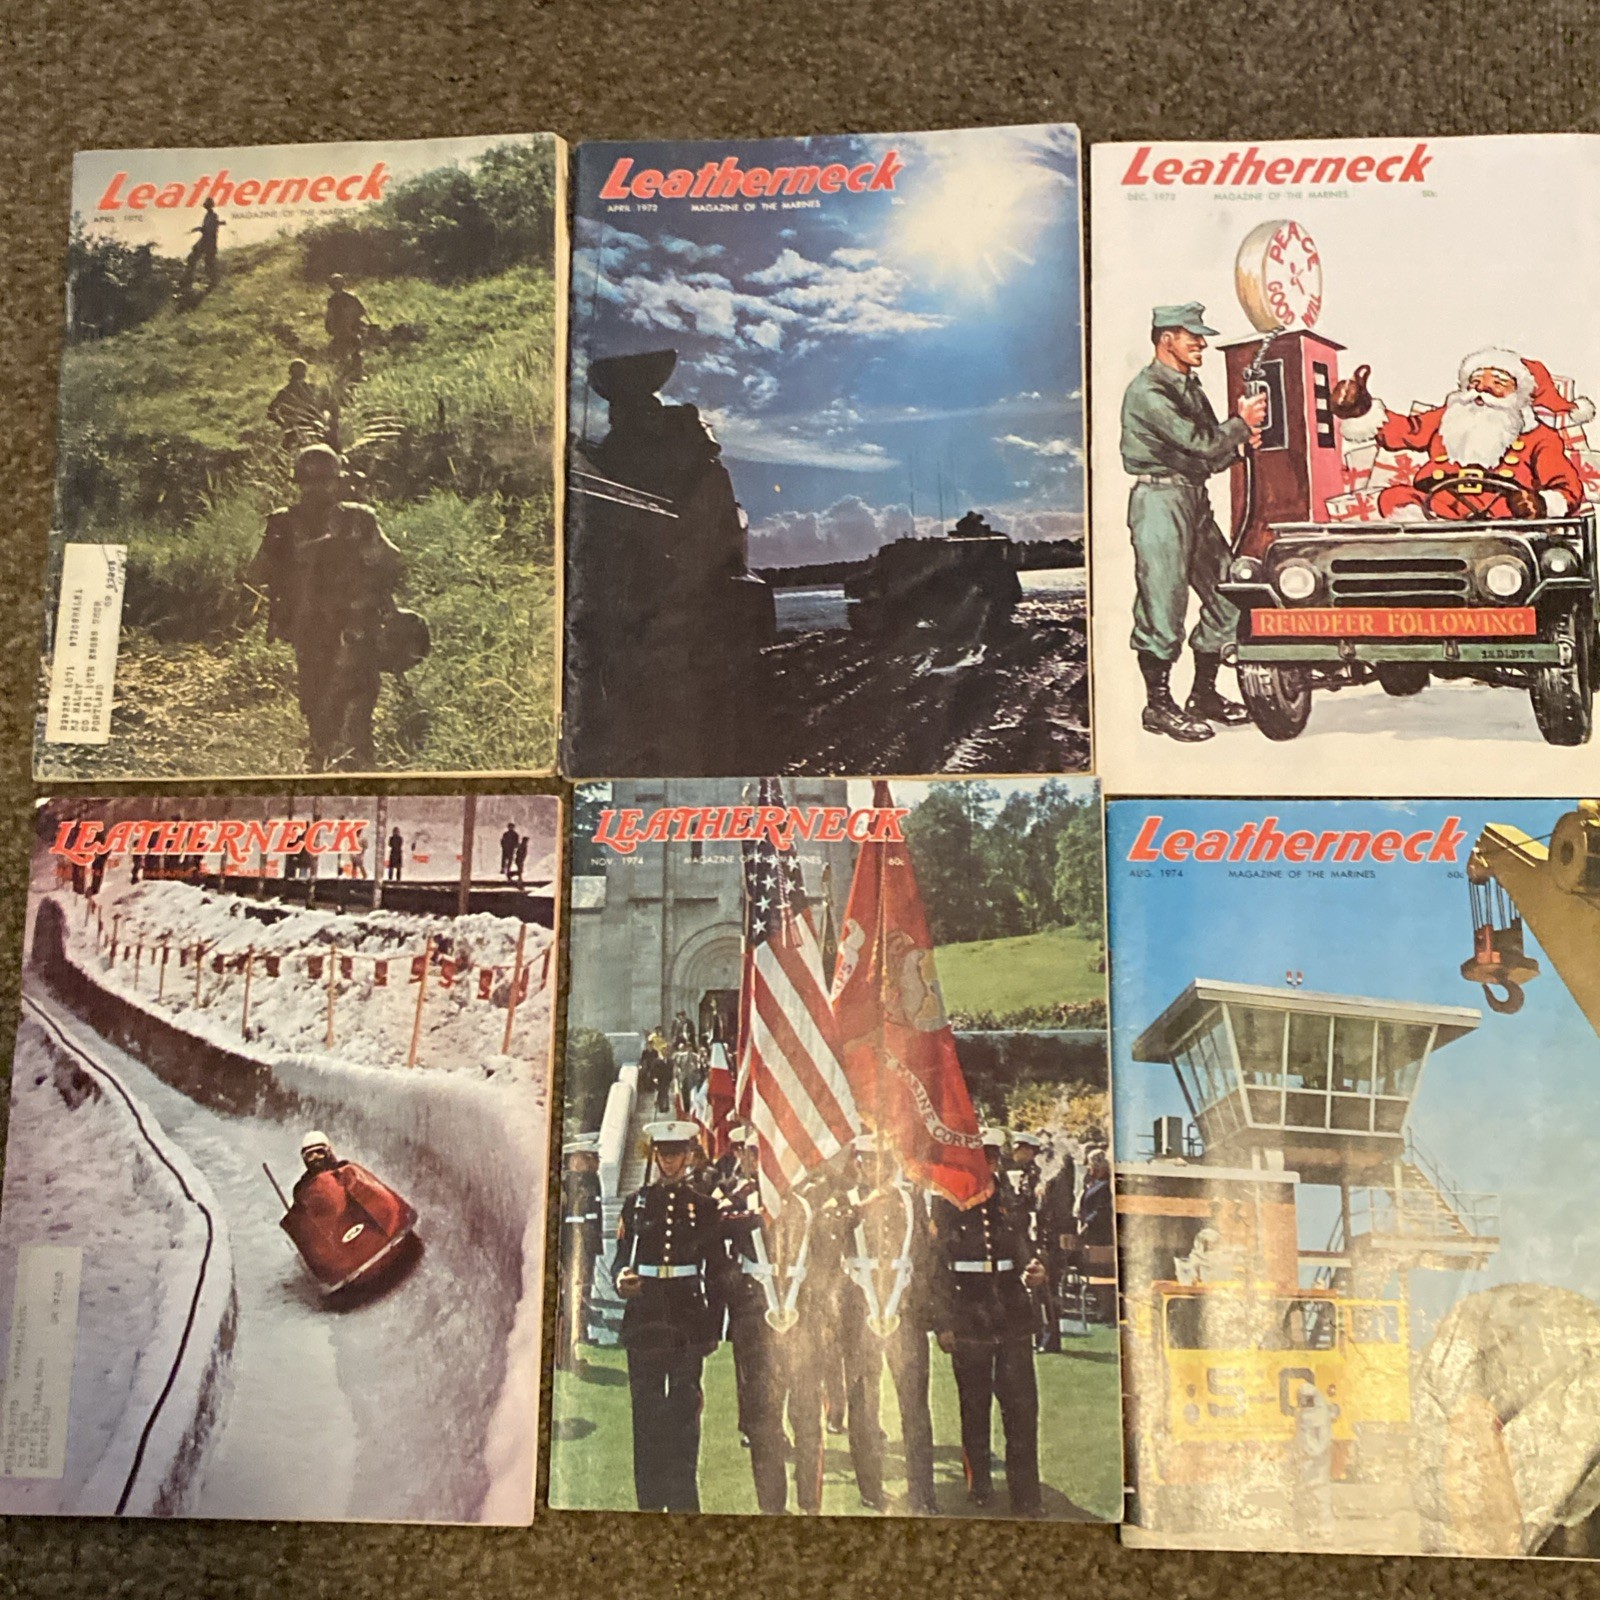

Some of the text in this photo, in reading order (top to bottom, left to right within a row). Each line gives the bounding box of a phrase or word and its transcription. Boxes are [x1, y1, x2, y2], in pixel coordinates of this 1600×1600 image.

[598, 150, 905, 199] Leatherneck
[1120, 143, 1433, 186] Leatherneck
[97, 161, 391, 211] Leatherneck
[1214, 190, 1349, 201] MAGAZINE OF THE MARINES
[232, 210, 277, 219] MAGAZINE
[607, 204, 631, 213] APRIL
[691, 200, 821, 212] MAGAZINE OF THE MARINES
[1269, 220, 1320, 271] PEACE
[1267, 281, 1296, 326] GOOD
[1260, 613, 1526, 633] REINDEER FOLLOWING
[91, 684, 105, 732] PORTLAND
[591, 806, 911, 855] LEATHERNECK
[1127, 815, 1467, 863] Leatherneck
[49, 819, 369, 867] LEATHERNECK
[622, 857, 644, 865] 1974
[684, 855, 735, 865] MAGAZINE
[1160, 869, 1183, 878] 1974
[1228, 870, 1376, 879] MAGAZINE OF THE MARINES
[933, 1126, 983, 1147] CORPS
